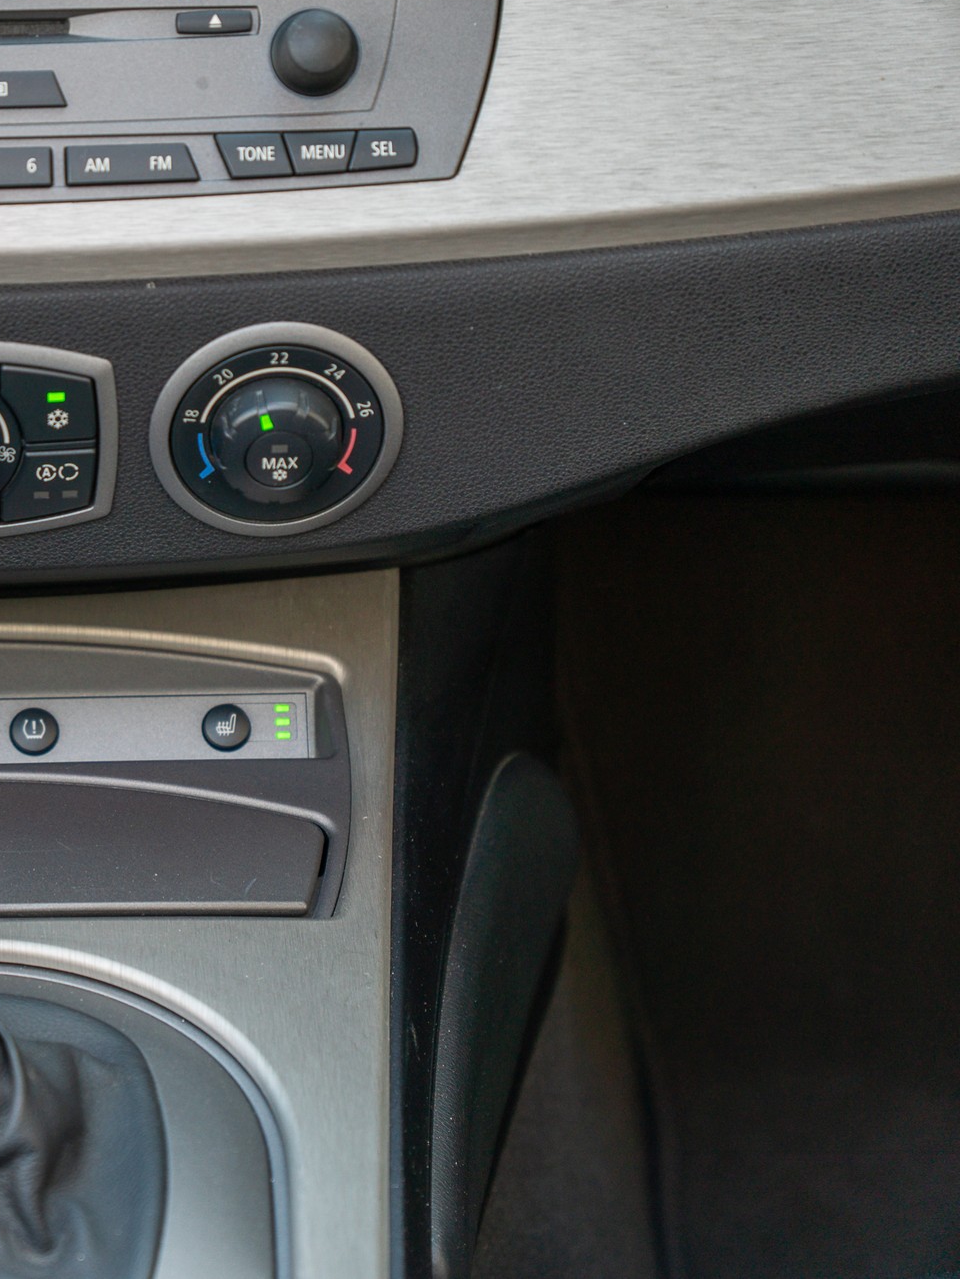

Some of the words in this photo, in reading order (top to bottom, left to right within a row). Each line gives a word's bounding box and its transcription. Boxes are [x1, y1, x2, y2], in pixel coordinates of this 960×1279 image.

[236, 145, 276, 162] TONE
[300, 144, 346, 160] MENU
[370, 140, 397, 157] SEL
[26, 157, 38, 174] 6
[84, 157, 111, 173] AM
[149, 155, 172, 171] FM
[269, 351, 289, 366] 22
[214, 367, 235, 385] 20
[323, 362, 346, 381] 24
[181, 407, 201, 425] 18
[356, 400, 373, 419] 26
[261, 456, 298, 471] MAX
